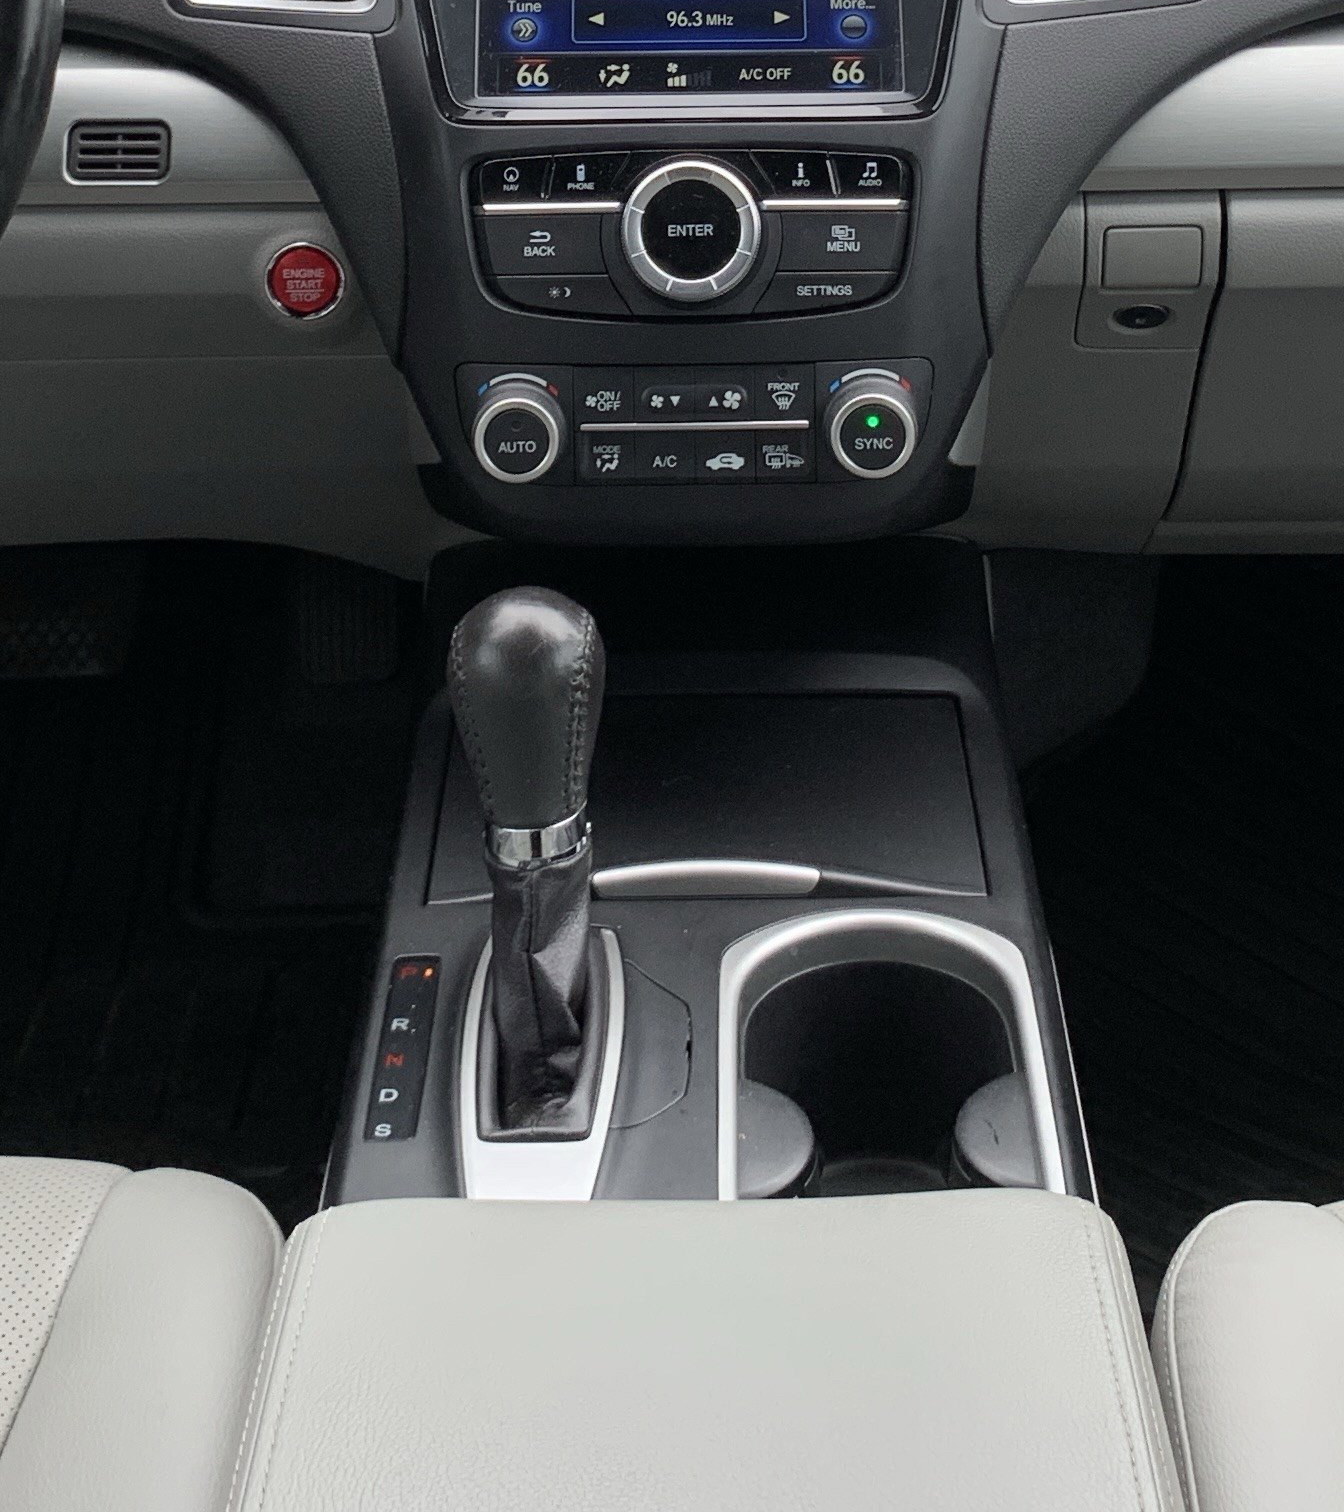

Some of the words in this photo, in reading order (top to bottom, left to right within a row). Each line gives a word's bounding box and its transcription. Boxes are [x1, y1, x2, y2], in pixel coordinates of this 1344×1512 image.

[508, 0, 542, 13] Tune
[666, 11, 704, 28] 96.3
[706, 14, 734, 27] MHz
[516, 63, 549, 88] 66
[739, 69, 763, 81] A/C
[766, 68, 792, 81] OFF
[831, 60, 865, 85] 66
[503, 184, 519, 192] NAV
[567, 182, 595, 191] PHONE
[791, 179, 810, 187] INFO
[858, 178, 883, 187] AUDIO
[667, 224, 714, 237] ENTER
[523, 246, 555, 257] BACK
[826, 241, 861, 252] MENU
[282, 268, 325, 279] ENGINE
[286, 279, 323, 290] START
[796, 285, 853, 296] SETTINGS
[289, 292, 321, 303] STOP
[767, 382, 800, 391] FRONT
[597, 390, 621, 401] ON/
[597, 401, 621, 412] OFF
[498, 440, 537, 454] AUTO
[593, 445, 621, 454] MODE
[762, 445, 789, 454] REAR
[855, 437, 893, 451] SYNC
[653, 454, 677, 468] A/C
[391, 1018, 409, 1031] R
[384, 1052, 404, 1066] N
[378, 1088, 399, 1102] D
[374, 1124, 392, 1137] S
